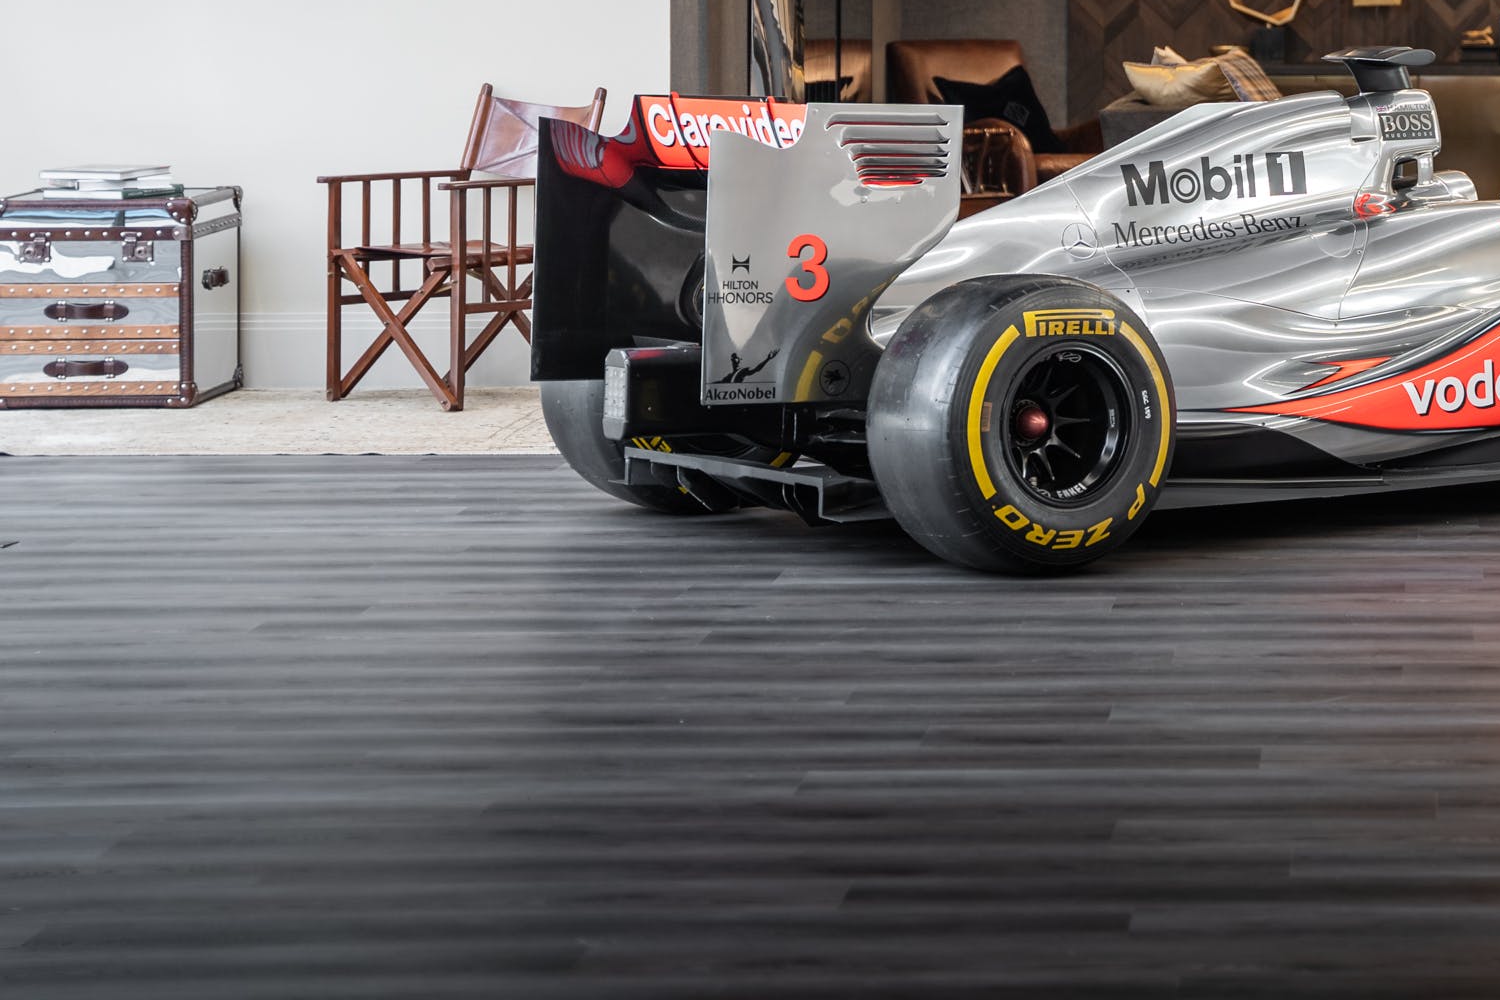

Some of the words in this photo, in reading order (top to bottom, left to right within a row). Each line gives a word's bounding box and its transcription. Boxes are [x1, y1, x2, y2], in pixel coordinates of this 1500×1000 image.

[1381, 113, 1432, 132] BOSS
[1120, 154, 1257, 207] Mobil
[1112, 213, 1307, 249] Mercedes-Benz
[785, 233, 830, 303] 3
[708, 292, 773, 304] HHONORS
[722, 281, 759, 290] HILTON
[1022, 308, 1116, 338] PIRELLI
[705, 387, 776, 401] AkzoNobel
[994, 504, 1114, 550] ZERO
